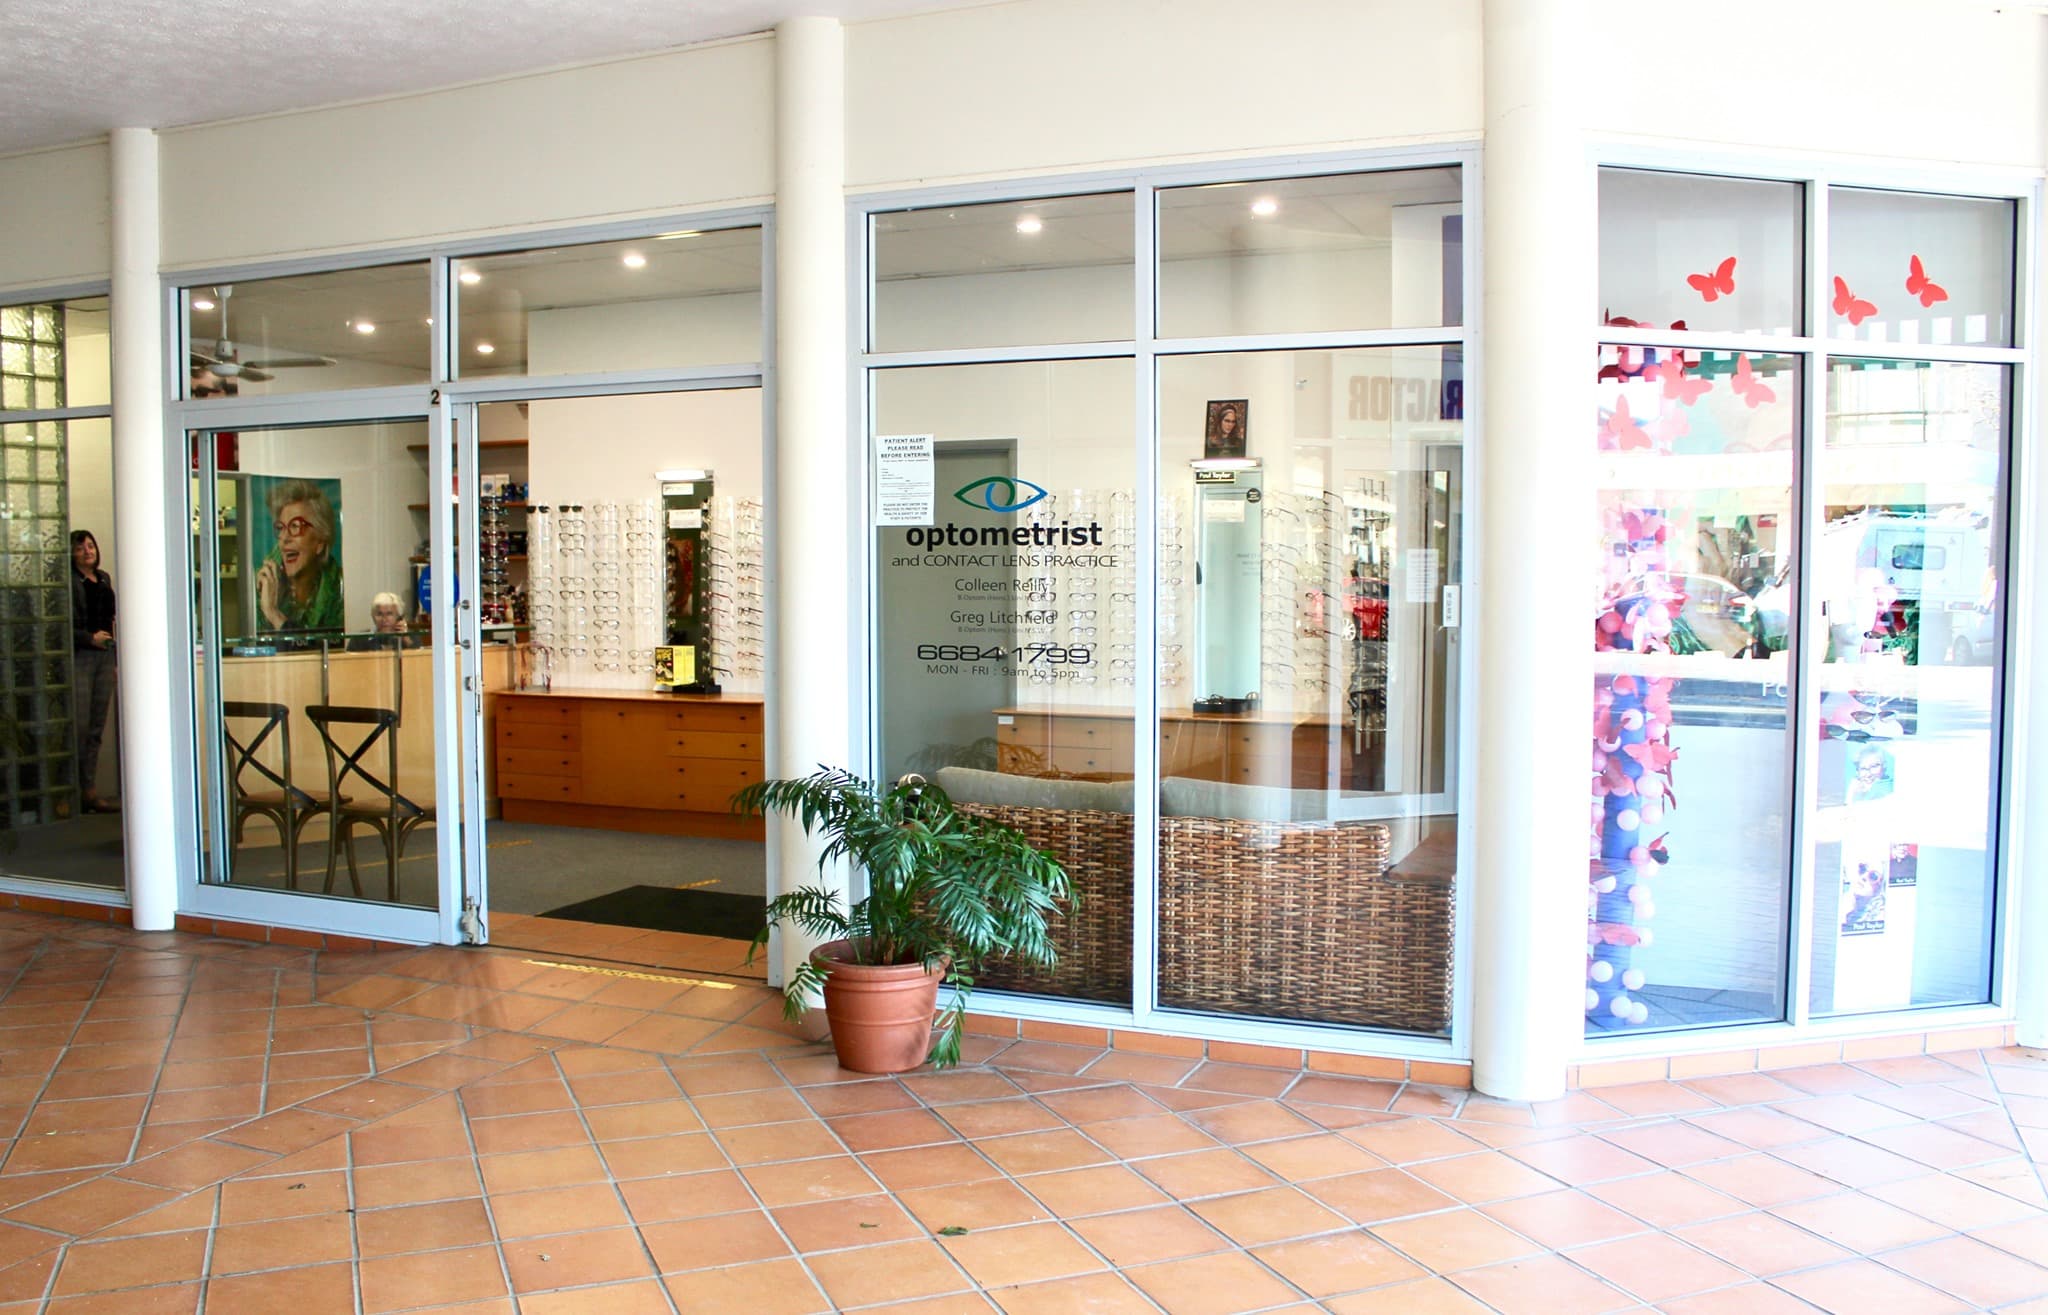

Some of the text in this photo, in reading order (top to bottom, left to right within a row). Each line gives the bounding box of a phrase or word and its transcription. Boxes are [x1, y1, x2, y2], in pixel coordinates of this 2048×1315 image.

[431, 389, 440, 405] 2
[906, 521, 1103, 552] optometrist
[892, 554, 1119, 568] and CONTACT LENS PRACTICE
[955, 578, 1048, 594] Colleen Reilly
[950, 610, 1055, 627] Greg Litchfield
[917, 645, 1090, 664] 6684 1799
[927, 664, 958, 675] MON
[971, 666, 989, 675] FRI
[1001, 667, 1029, 677] 9am
[1034, 668, 1046, 677] to
[1052, 668, 1080, 679] 5pm
